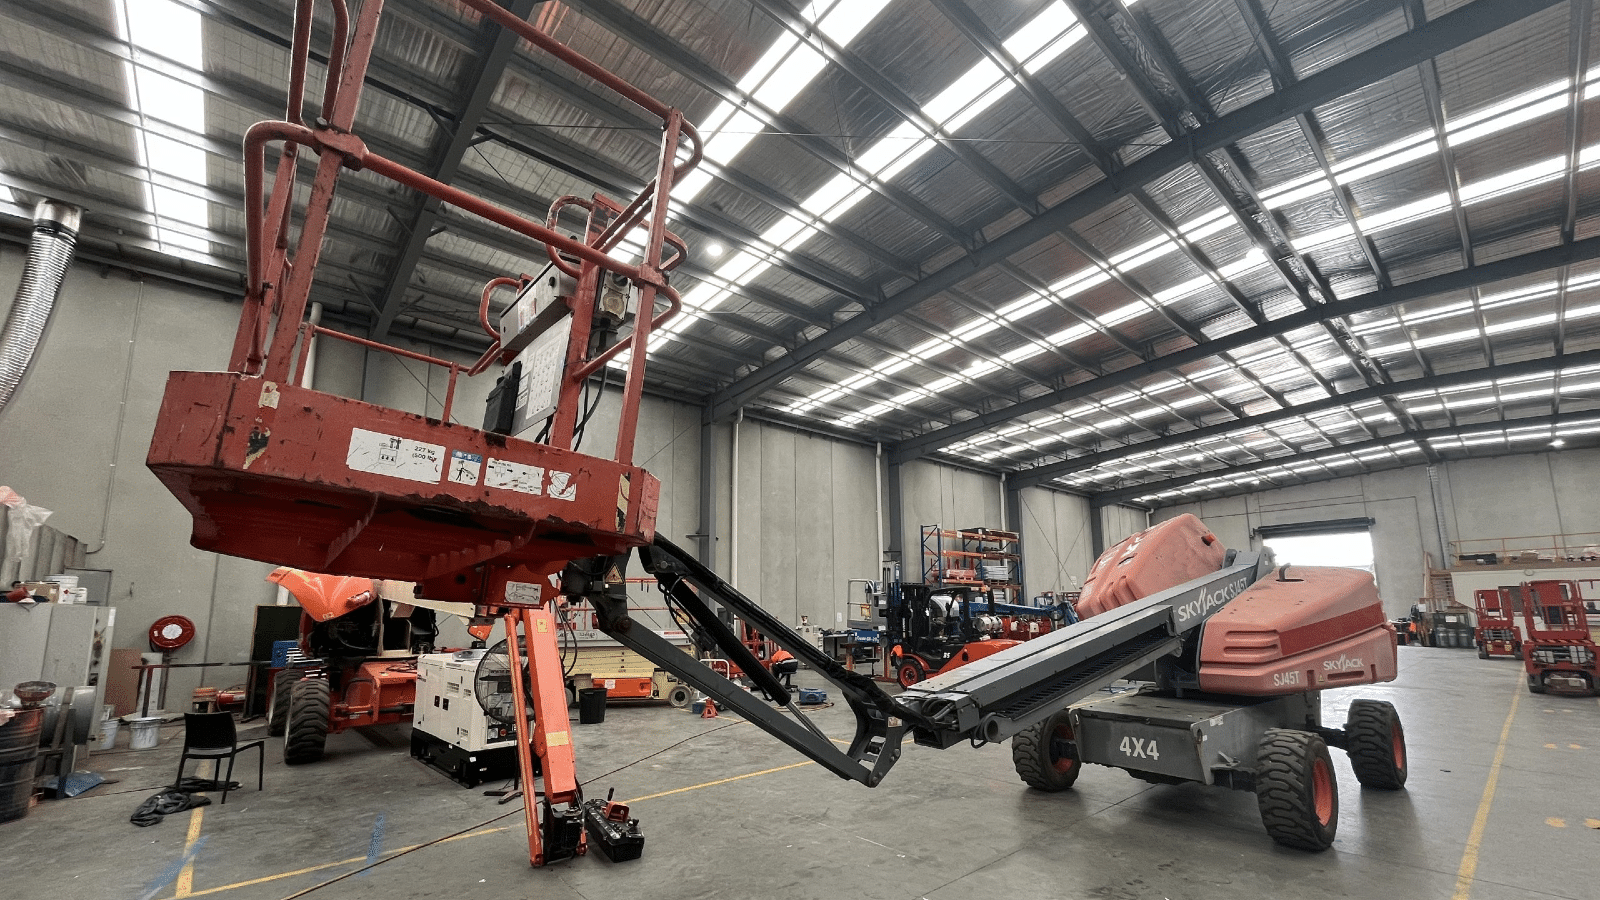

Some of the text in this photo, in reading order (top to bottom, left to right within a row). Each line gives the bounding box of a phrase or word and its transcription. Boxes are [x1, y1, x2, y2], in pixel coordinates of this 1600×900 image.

[1177, 577, 1247, 622] SKYJACK SJ45T
[1323, 653, 1365, 671] SKYJACK
[1273, 671, 1300, 687] SJ45T
[1119, 736, 1160, 761] 4X4
